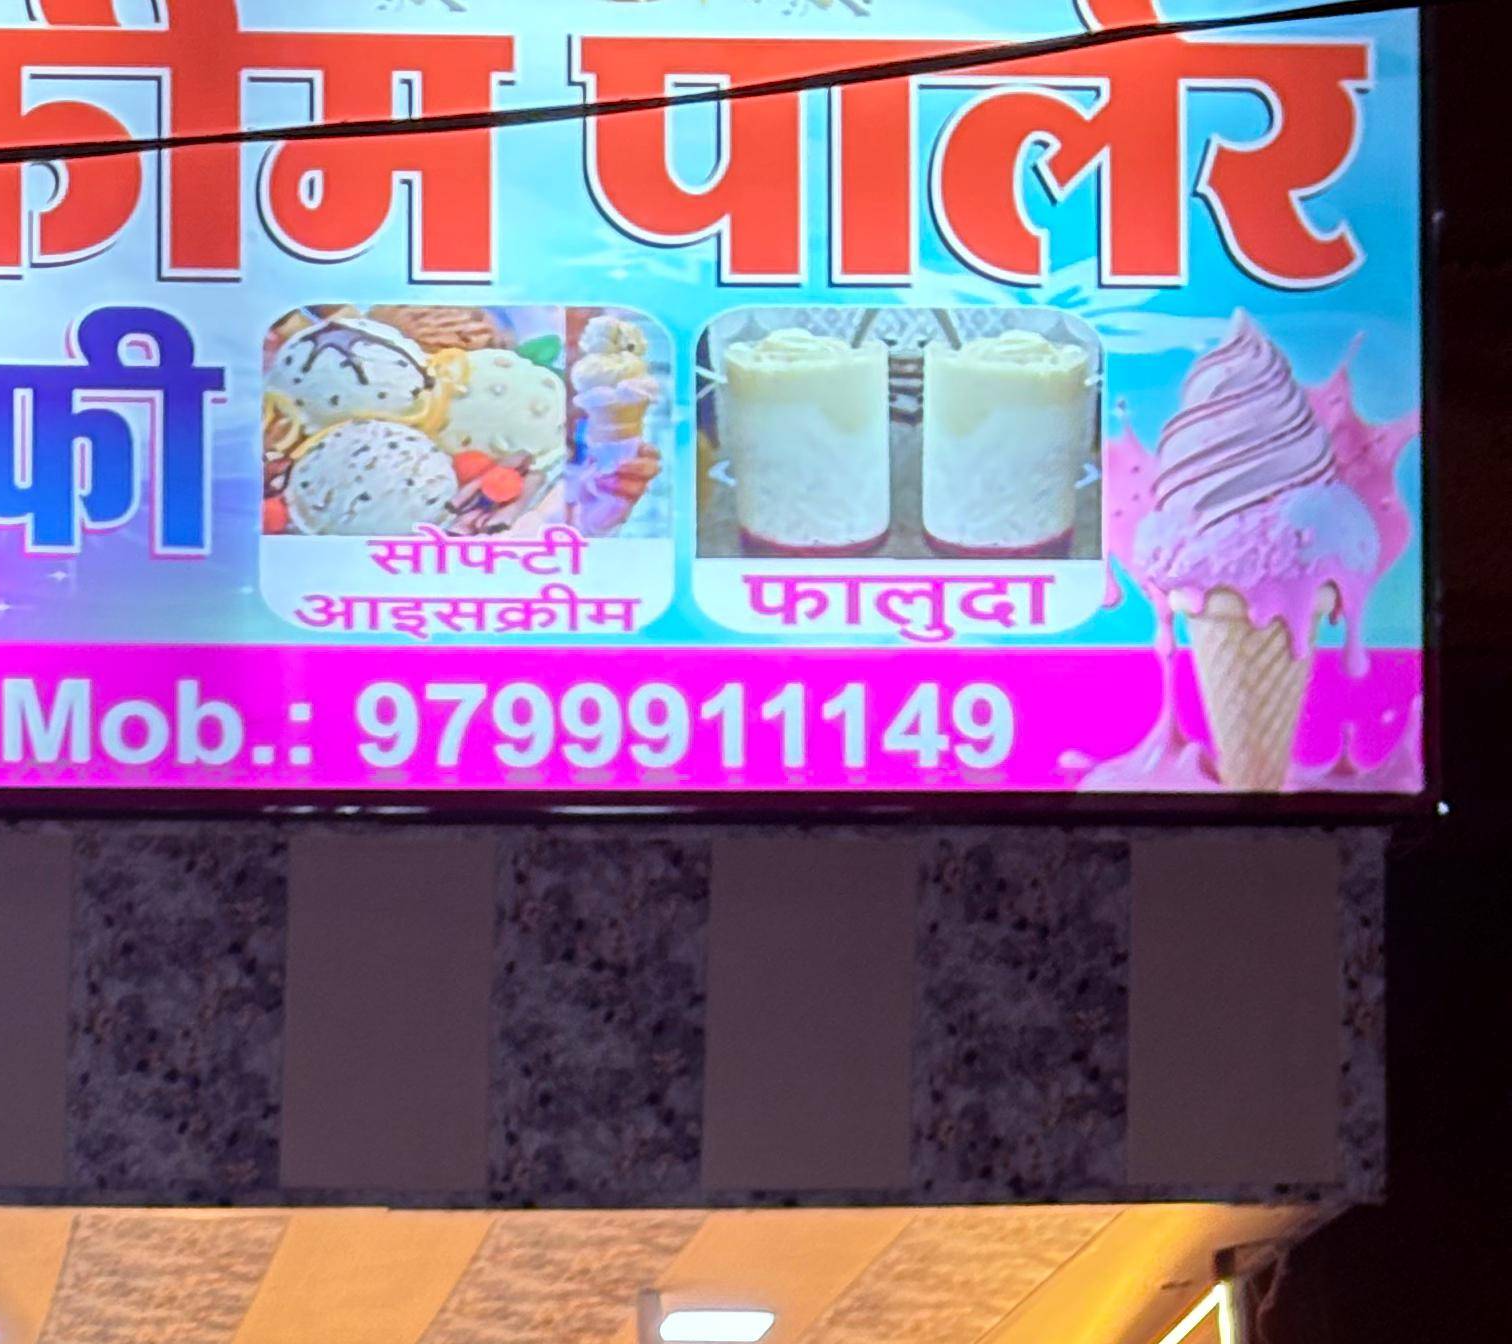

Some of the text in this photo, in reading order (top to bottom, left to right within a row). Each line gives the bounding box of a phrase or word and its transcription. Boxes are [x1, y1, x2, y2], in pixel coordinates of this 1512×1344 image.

[366, 525, 589, 576] सोफ्टी
[294, 582, 642, 640] आइसक्रीम
[742, 575, 1055, 643] फालुदा
[0, 677, 313, 766] Mob.:
[354, 681, 1016, 770] 9799911149
